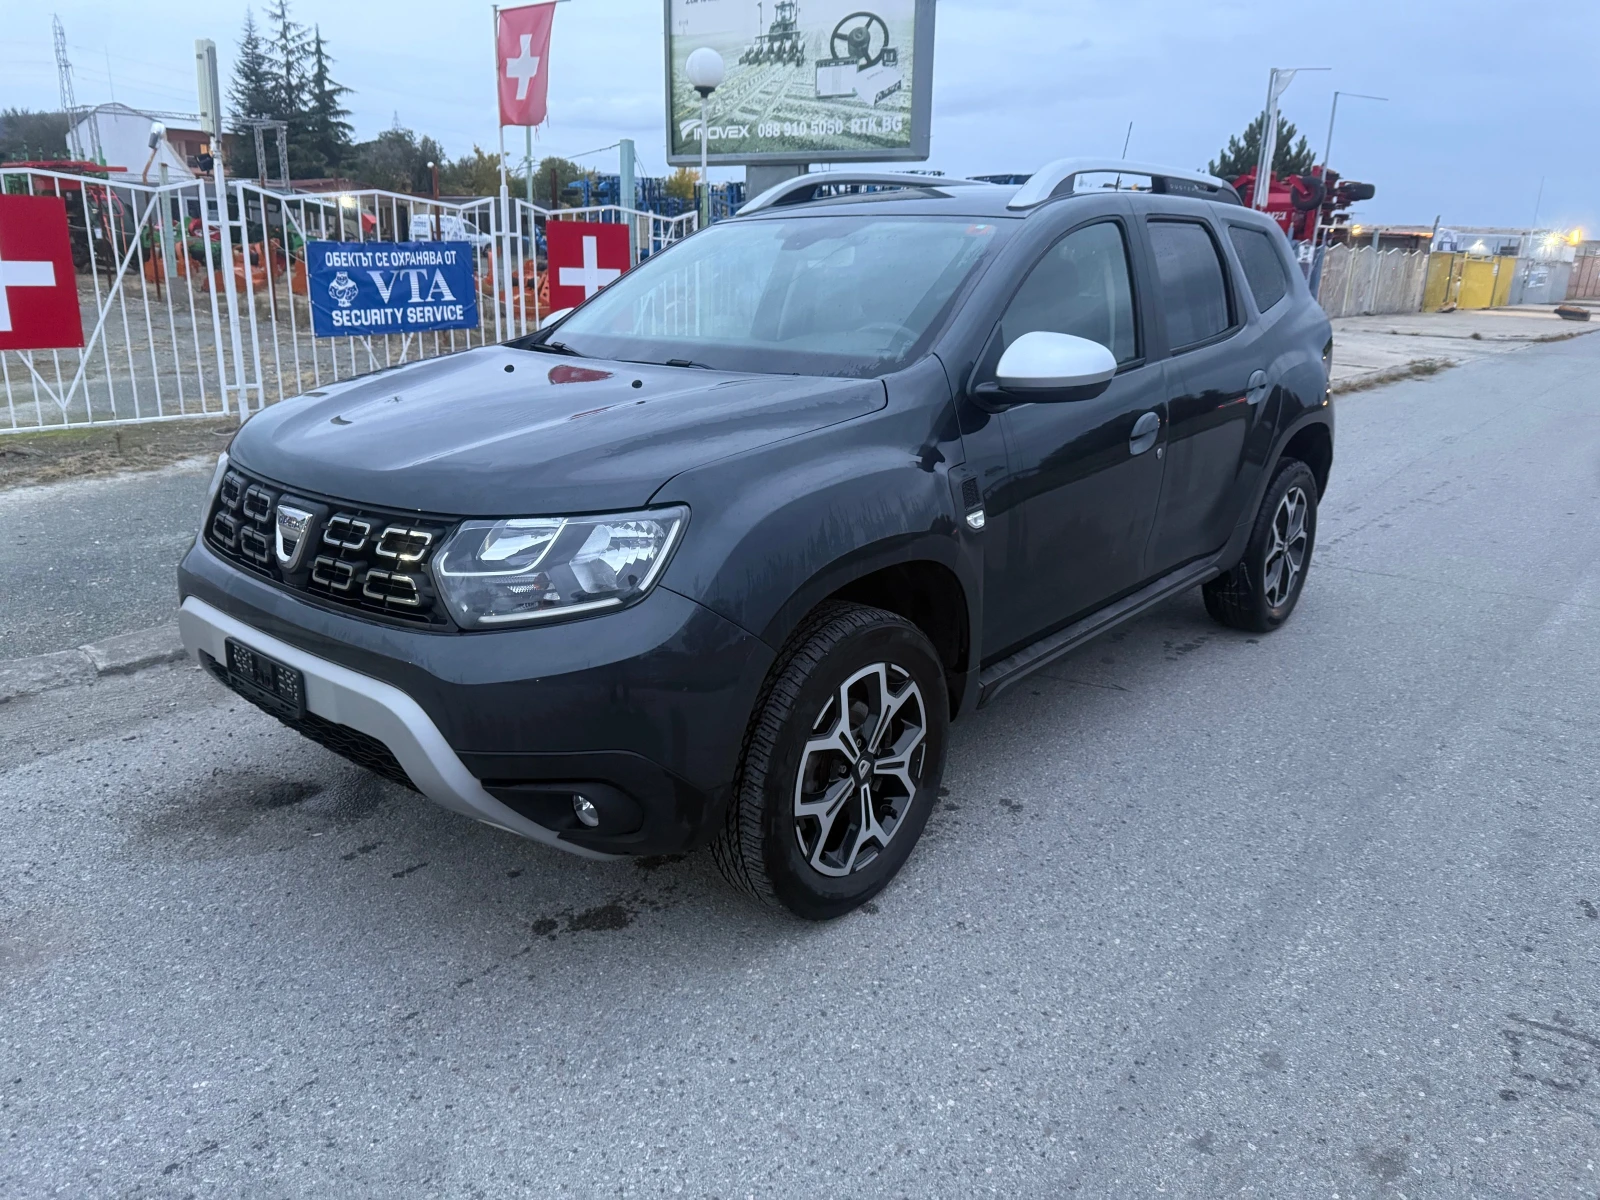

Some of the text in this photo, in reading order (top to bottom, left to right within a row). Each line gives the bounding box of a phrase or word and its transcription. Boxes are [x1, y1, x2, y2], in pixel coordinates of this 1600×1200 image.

[758, 123, 780, 138] 088
[783, 121, 807, 137] 910
[810, 119, 843, 135] 5050
[850, 115, 903, 134] RTK.BG
[325, 250, 457, 267] ОБЕКТЪТ СЕ ОХРАНЯВА ОТ
[366, 267, 457, 304] VTA
[331, 304, 464, 327] SECURITY SERVICE
